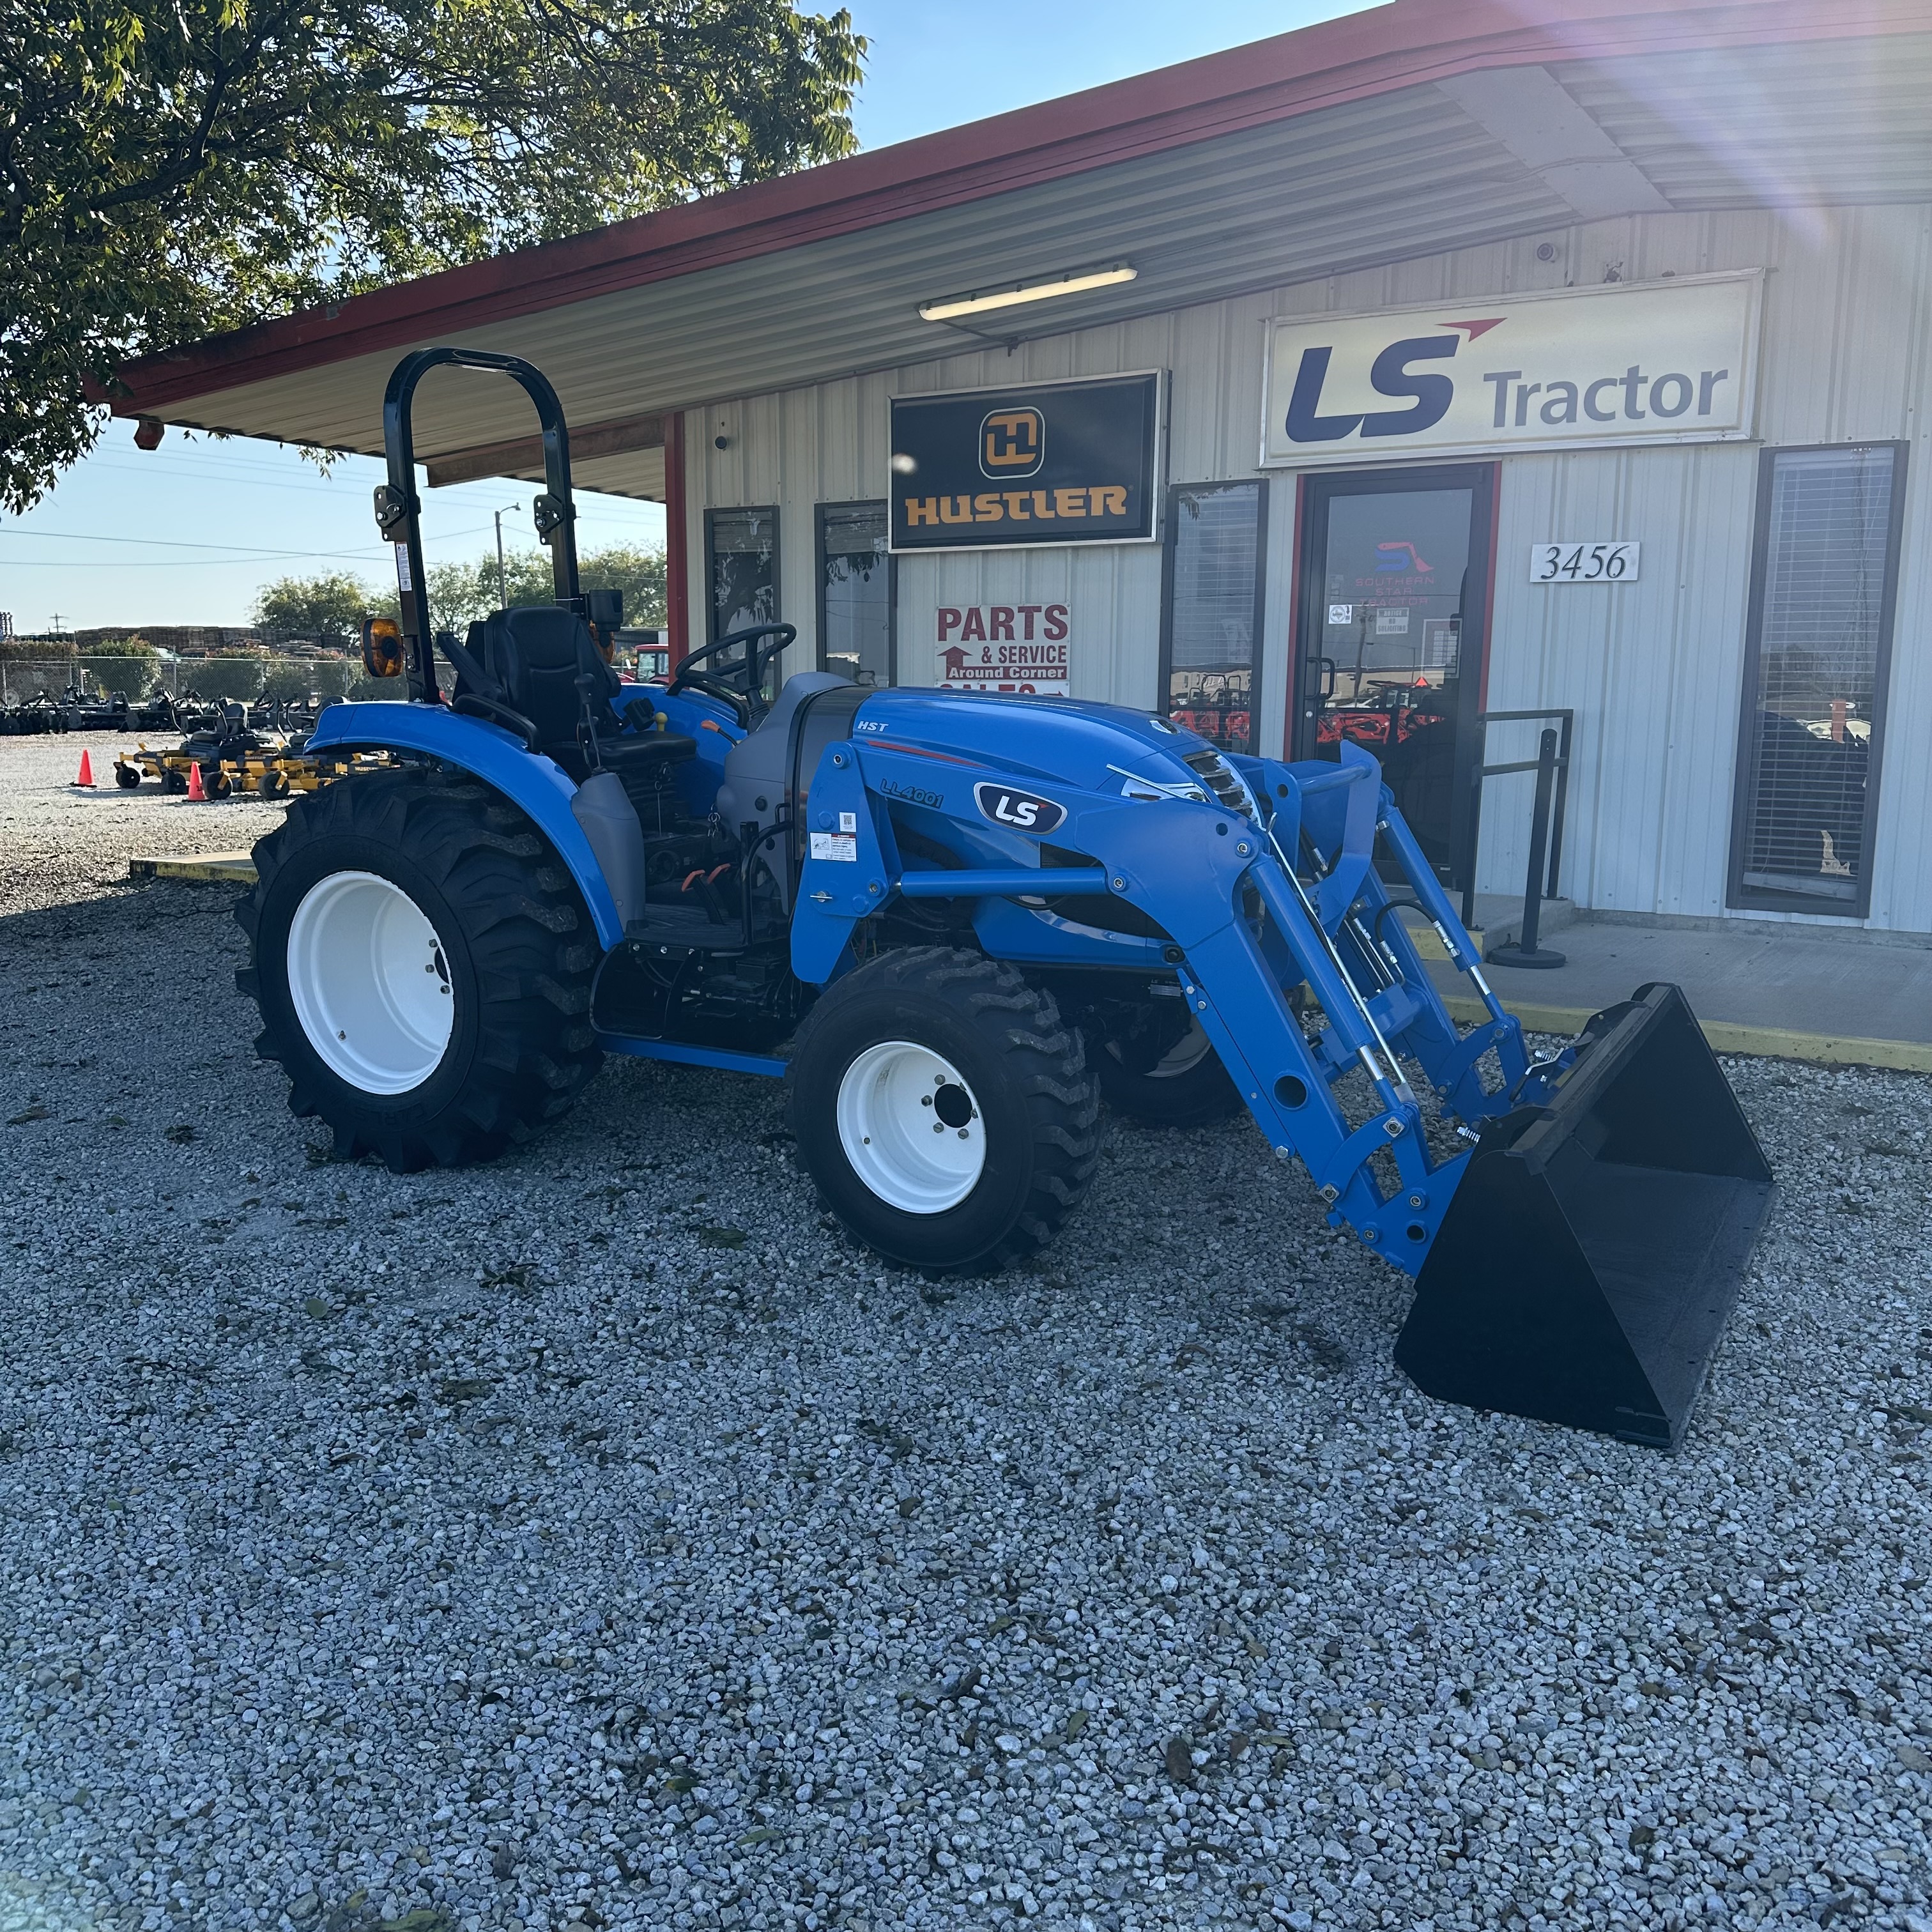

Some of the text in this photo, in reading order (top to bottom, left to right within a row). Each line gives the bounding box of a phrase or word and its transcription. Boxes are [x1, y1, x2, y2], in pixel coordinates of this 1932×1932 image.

[1285, 334, 1728, 442] LS Tractor
[905, 486, 1127, 526] HUSTLER
[1540, 545, 1630, 579] 3456
[1355, 576, 1434, 586] SOUTHERN
[1375, 587, 1413, 596] STAR
[1359, 597, 1429, 606] TRACTOR
[938, 604, 1068, 642] PARTS
[981, 645, 1067, 664] & SERVICE
[949, 667, 1064, 678] Around Corner
[857, 721, 889, 732] HST
[880, 778, 944, 809] LL4001
[995, 795, 1039, 826] LS
